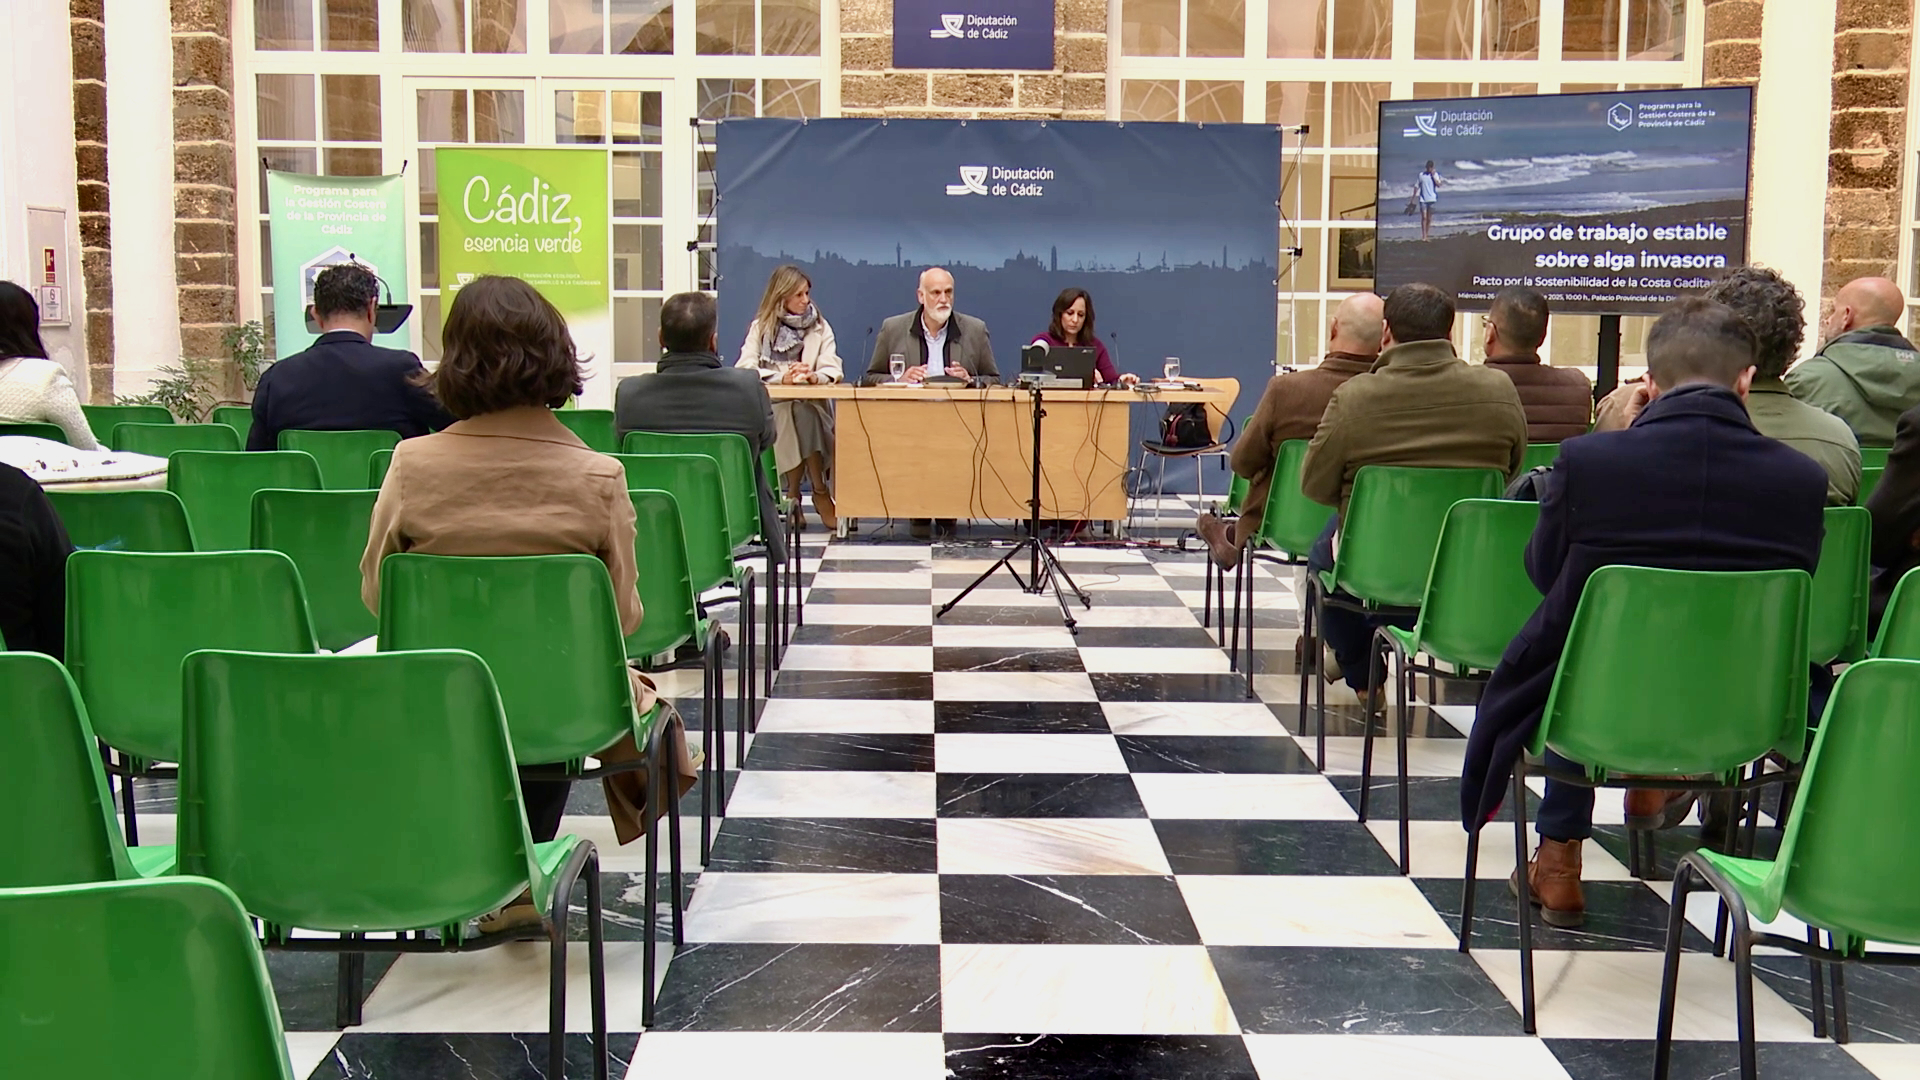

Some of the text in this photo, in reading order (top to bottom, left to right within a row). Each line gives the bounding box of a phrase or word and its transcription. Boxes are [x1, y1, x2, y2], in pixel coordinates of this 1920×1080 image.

[967, 14, 1018, 27] Diputación
[967, 27, 1009, 39] de Cádiz
[1639, 103, 1675, 111] Programa
[1676, 102, 1693, 110] para
[1441, 109, 1493, 123] Diputación
[1668, 110, 1696, 118] Costera
[1638, 120, 1672, 128] Provincia
[1684, 118, 1706, 126] Cádiz
[1440, 124, 1483, 136] de Cádiz
[992, 166, 1054, 182] Diputación
[293, 185, 377, 197] Programa para
[991, 182, 1043, 196] de Cádiz
[285, 197, 387, 209] la Gestión Costera
[463, 175, 582, 234] Cádiz,
[286, 211, 387, 222] de la Provincia de
[321, 225, 353, 235] Cádiz
[1487, 223, 1728, 244] Grupo de trabajo estable
[463, 231, 582, 253] esencia verde
[1535, 250, 1726, 271] sobre alga invasora
[1472, 276, 1718, 289] Pacto por la Sostenibilidad de la Costa Gaditan
[1565, 293, 1583, 301] 10:00
